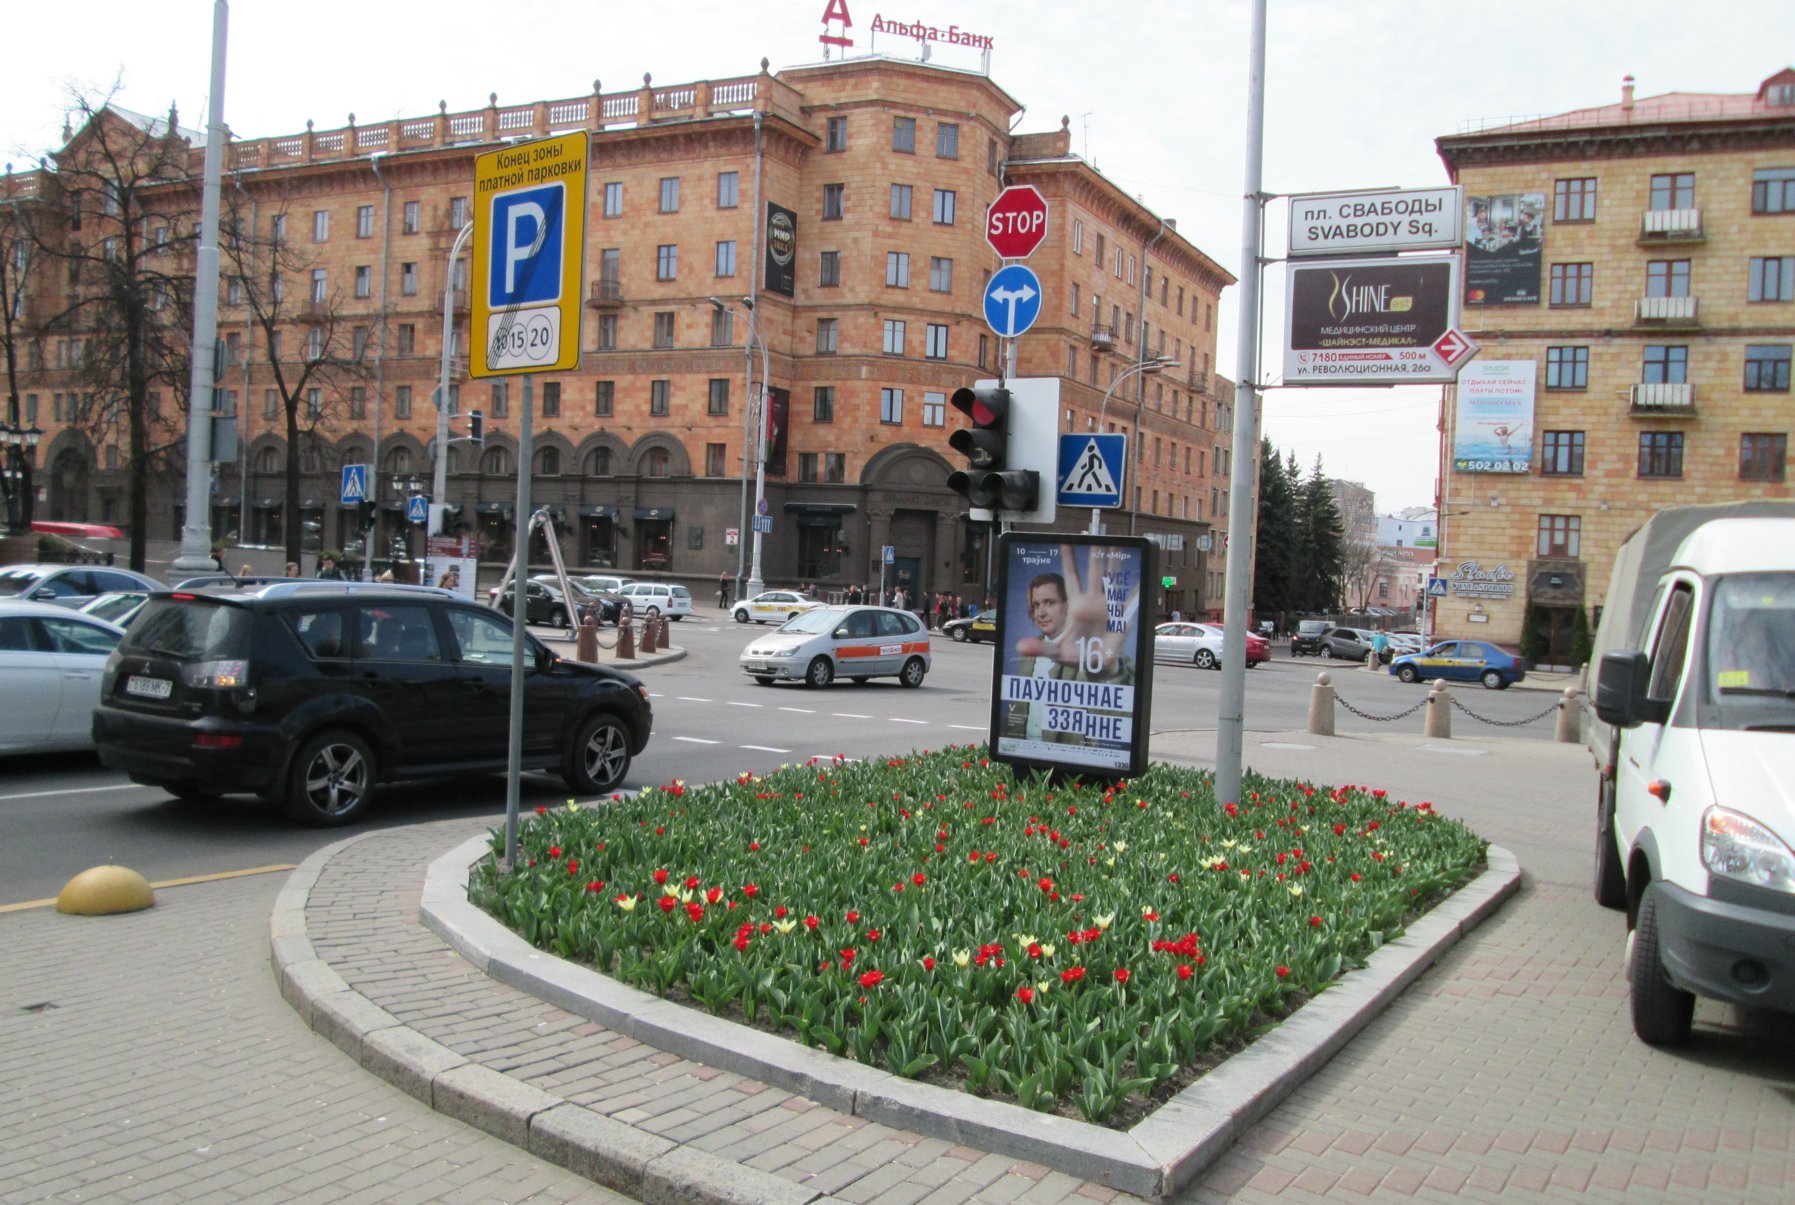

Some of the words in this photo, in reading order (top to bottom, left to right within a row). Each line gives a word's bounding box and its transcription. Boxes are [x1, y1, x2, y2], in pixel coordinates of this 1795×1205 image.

[496, 153, 530, 170] Конец
[533, 143, 563, 162] зоны
[479, 167, 524, 193] платной
[527, 158, 582, 183] парковки
[1304, 209, 1332, 221] пл.
[1338, 197, 1443, 219] СВАБОДЫ
[990, 210, 1044, 235] STOP
[1308, 221, 1402, 241] SVABODY
[1408, 219, 1438, 238] Sq.
[505, 202, 546, 294] P
[1341, 273, 1391, 324] SHINE
[1320, 325, 1389, 335] МЕДИЦИНСКИЙ
[1390, 324, 1416, 334] ЦЕНТР
[496, 334, 509, 350] 10
[511, 331, 525, 349] 15
[530, 326, 549, 347] 20
[1312, 353, 1336, 363] 7180
[1400, 352, 1417, 360] 500
[1297, 366, 1310, 376] ул.
[1312, 364, 1410, 375] РЕВОЛЮЦИОННАЯ,
[1468, 461, 1491, 470] 502
[1494, 461, 1511, 470] 02
[1513, 461, 1529, 470] 02
[1022, 556, 1051, 565] траўня
[1106, 551, 1131, 560] «Мір»
[1108, 570, 1130, 586] УСЁ
[1107, 588, 1127, 602] МАГ
[1107, 604, 1124, 618] ЧЫ
[1106, 620, 1126, 634] МА!
[1009, 676, 1124, 709] ПАЎНОЧНАЕ
[1048, 708, 1122, 740] ЗЗЯННЕ
[1114, 761, 1129, 769] 1230
